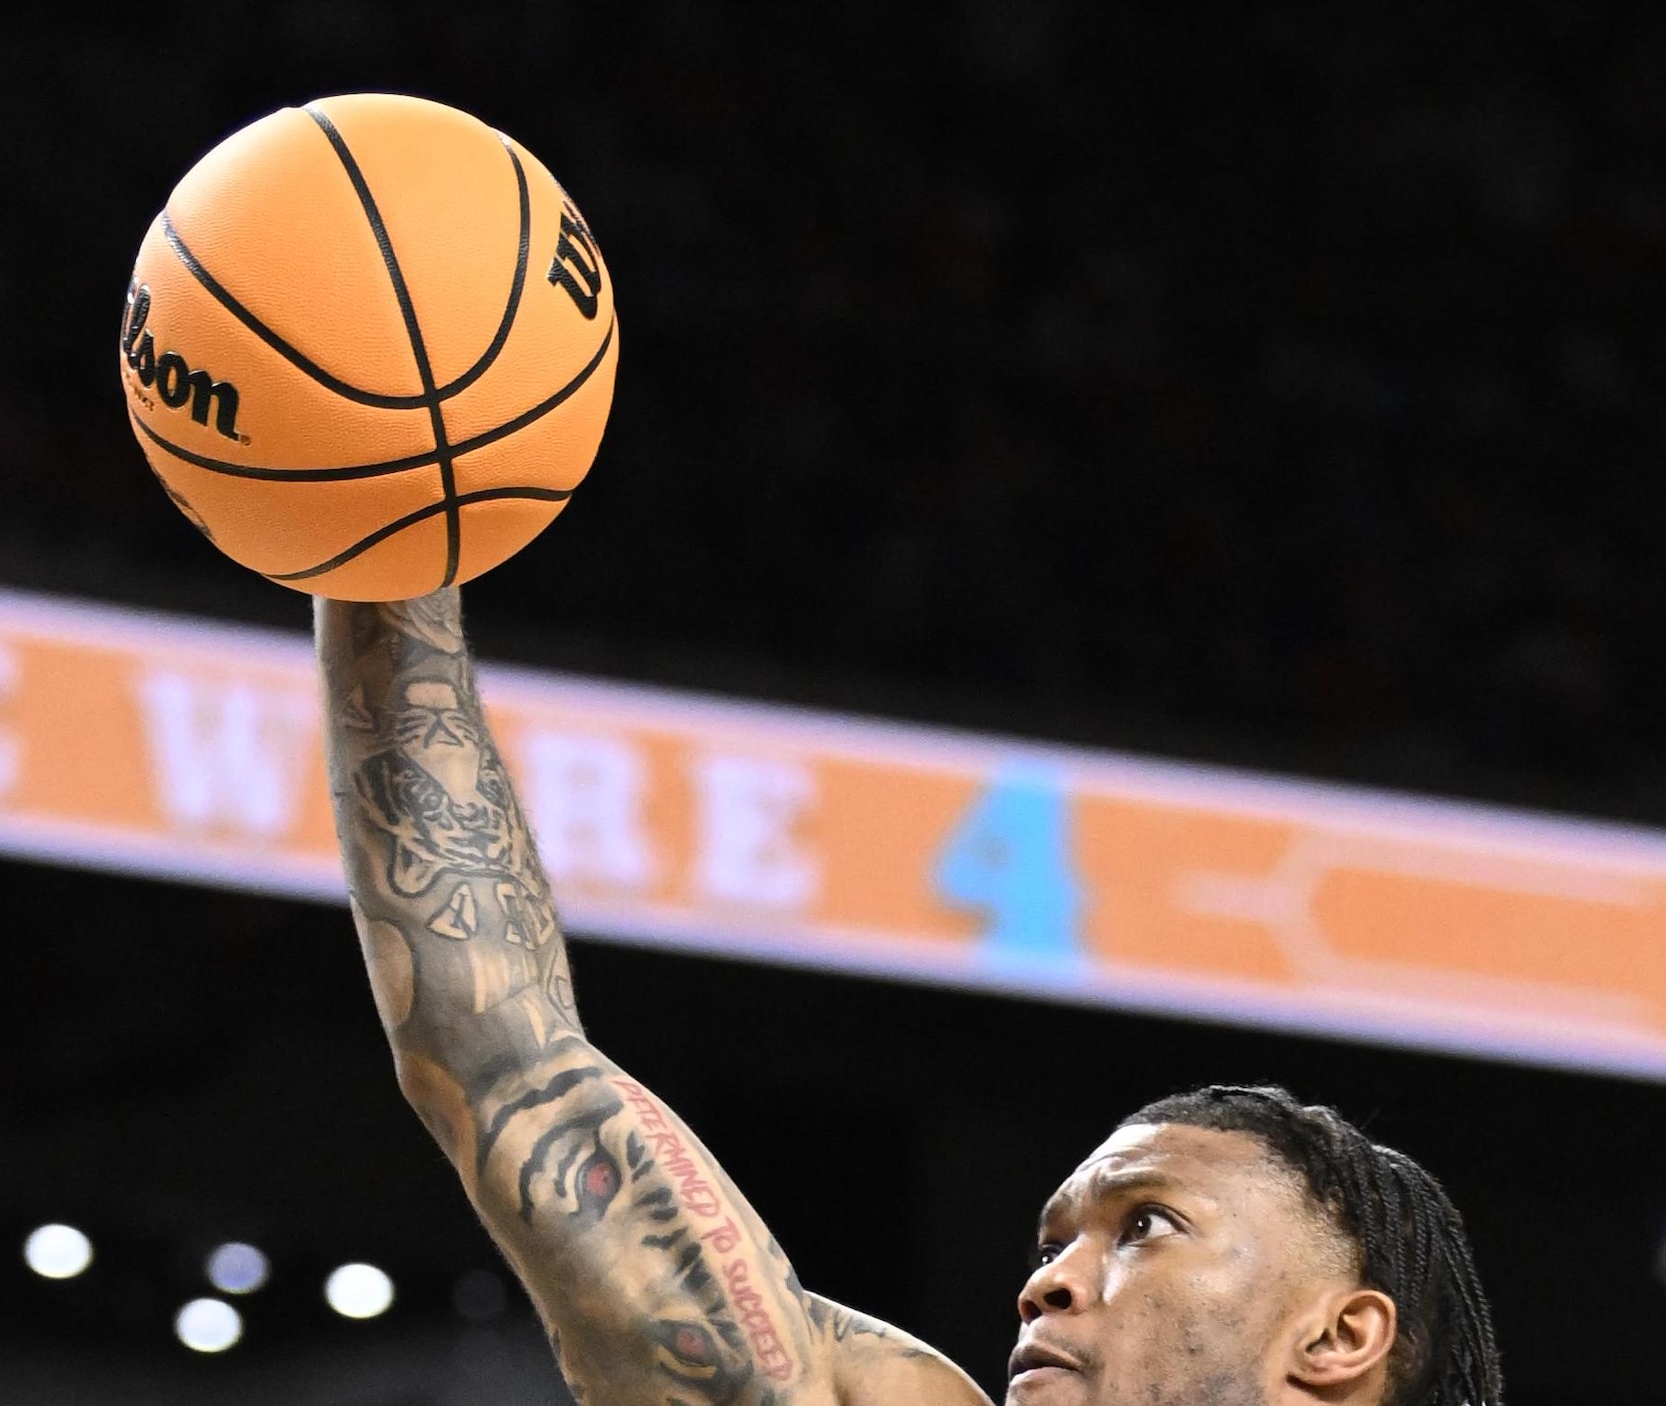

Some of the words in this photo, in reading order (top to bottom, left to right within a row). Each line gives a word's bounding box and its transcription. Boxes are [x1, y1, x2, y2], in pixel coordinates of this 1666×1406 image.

[133, 670, 821, 906] WRE
[930, 756, 1085, 976] 4
[700, 1215, 743, 1254] TO
